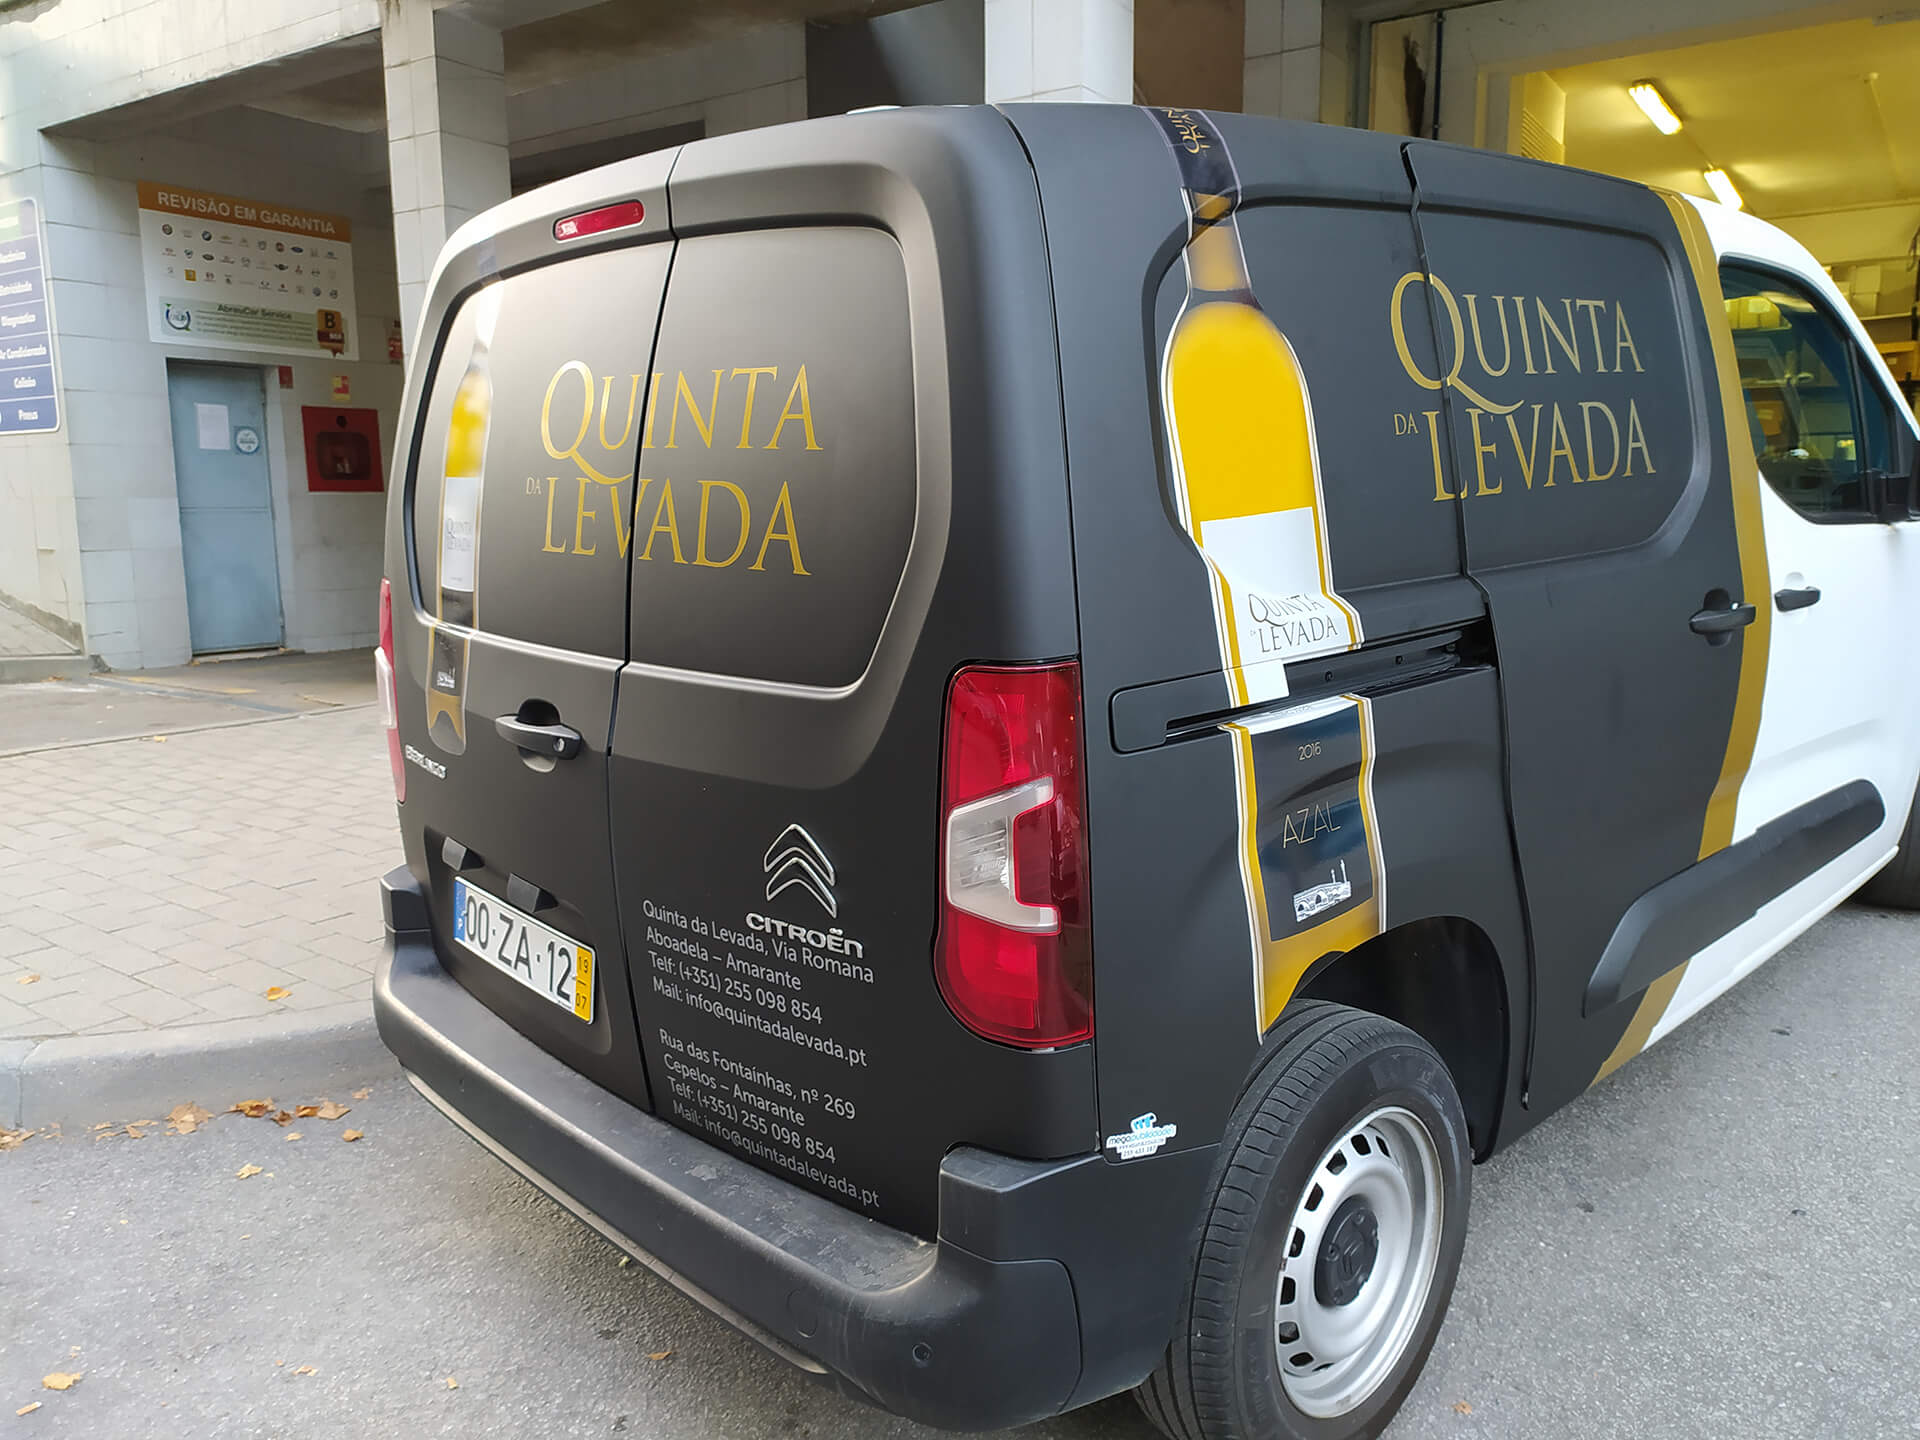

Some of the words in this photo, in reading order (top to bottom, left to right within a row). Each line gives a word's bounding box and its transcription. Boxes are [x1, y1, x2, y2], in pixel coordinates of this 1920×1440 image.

[158, 191, 230, 216] REVISÃO
[234, 205, 257, 220] EM
[260, 210, 336, 235] GARANTIA
[324, 312, 336, 328] B
[1390, 271, 1646, 415] QUINTA
[541, 360, 824, 485] QUINTA
[1394, 412, 1418, 436] DA
[1421, 399, 1657, 502] LEVADA
[525, 476, 542, 495] DA
[541, 477, 812, 576] LEVADA
[1248, 593, 1326, 627] QUINTA
[1258, 614, 1339, 653] LEVADA
[1298, 741, 1322, 761] 2016
[1283, 801, 1342, 849] AZAL
[643, 900, 687, 930] Quinta
[691, 916, 708, 936] da
[712, 921, 769, 956] Levada,
[772, 938, 797, 962] Via
[802, 949, 874, 984] Romana
[646, 926, 708, 962] Aboadela
[726, 953, 802, 991] Amarante
[648, 950, 677, 976] Telf:
[679, 961, 721, 993] (+351)
[724, 978, 751, 1001] 255
[756, 988, 787, 1013] 098
[791, 1000, 822, 1024] 854
[653, 976, 683, 1002] Mail:
[686, 988, 868, 1067] info@quintadalevada.pt
[660, 1028, 684, 1053] Rua
[687, 1042, 710, 1064] das
[824, 1094, 856, 1119] 269
[664, 1053, 717, 1089] Cepelos
[733, 1084, 805, 1127] Amarante
[667, 1076, 695, 1101] Telf:
[698, 1089, 738, 1123] (+351)
[741, 1110, 768, 1134] 255
[771, 1123, 801, 1149] 098
[805, 1137, 836, 1163] 854
[673, 1100, 701, 1125] Mail:
[704, 1114, 880, 1208] info@quintadalevada.pt
